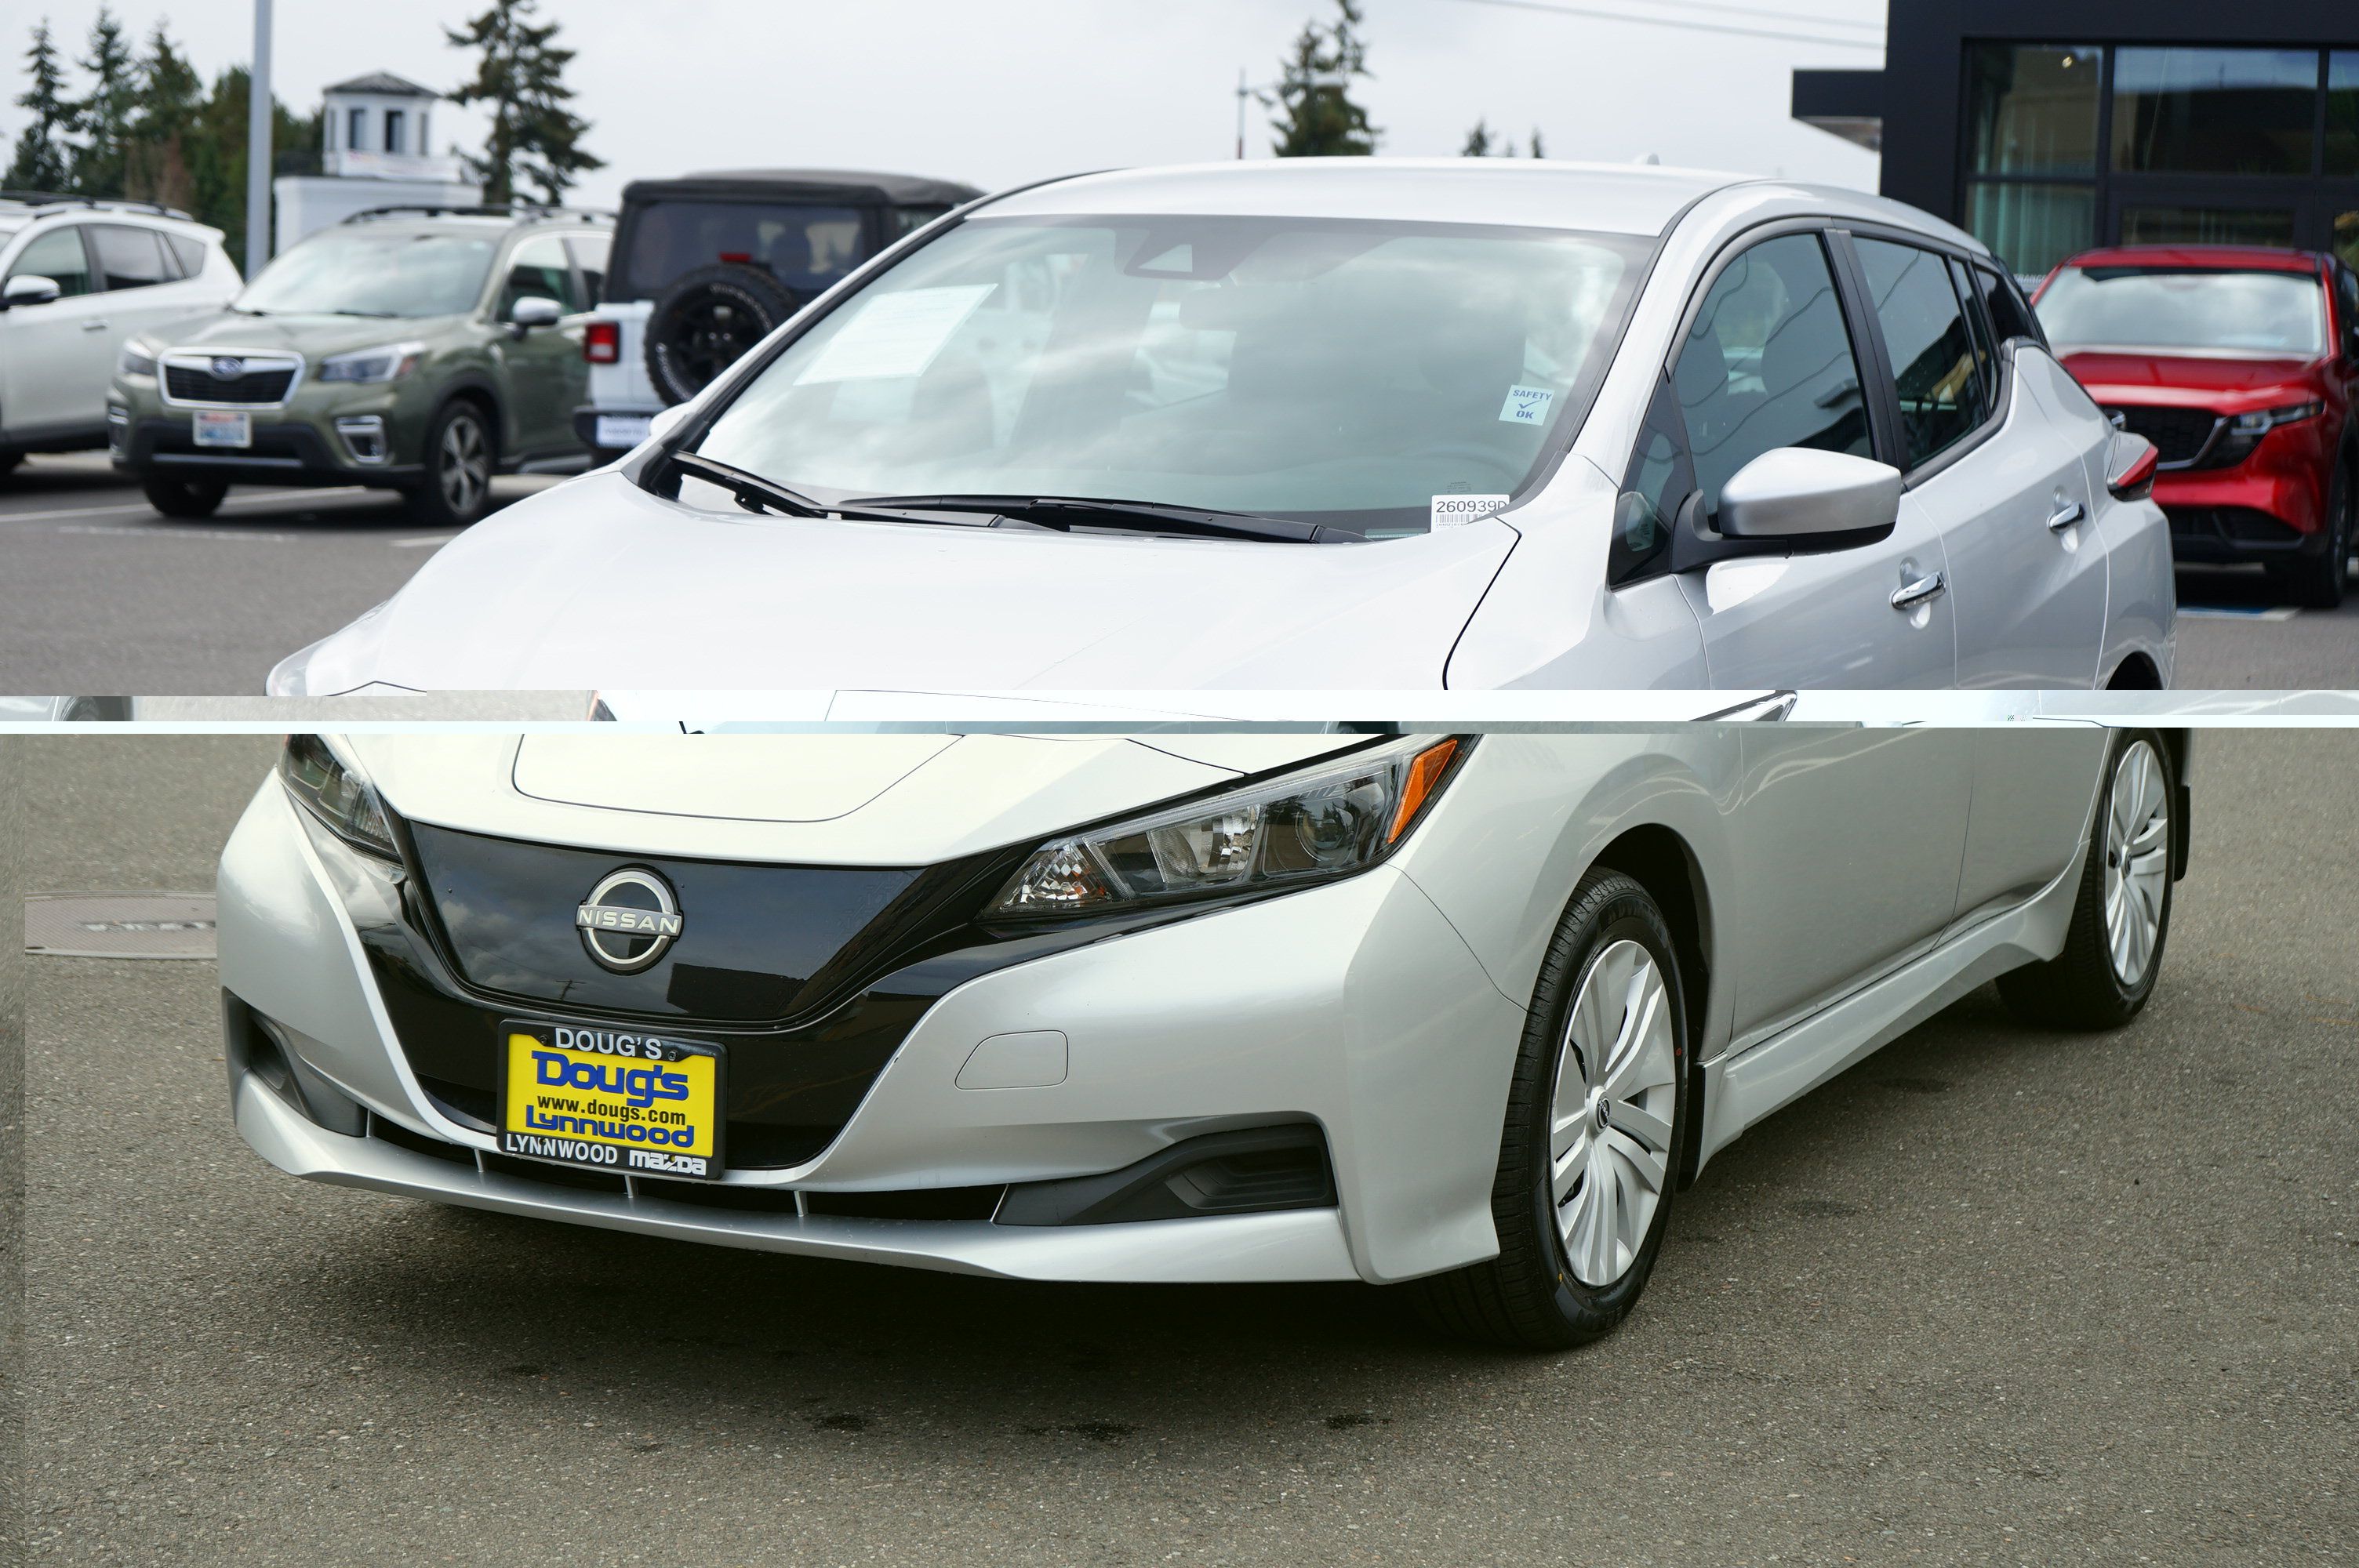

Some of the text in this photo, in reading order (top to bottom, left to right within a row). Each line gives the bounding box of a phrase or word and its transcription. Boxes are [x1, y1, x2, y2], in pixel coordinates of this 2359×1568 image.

[1513, 389, 1552, 401] SAFETY
[1516, 410, 1535, 419] OK
[578, 908, 678, 934] NISSAN
[554, 1027, 662, 1060] DOUG'S
[537, 1095, 686, 1126] www.dougs.com
[525, 1105, 695, 1149] Lynnwood
[506, 1133, 618, 1165] LYNNWOOD
